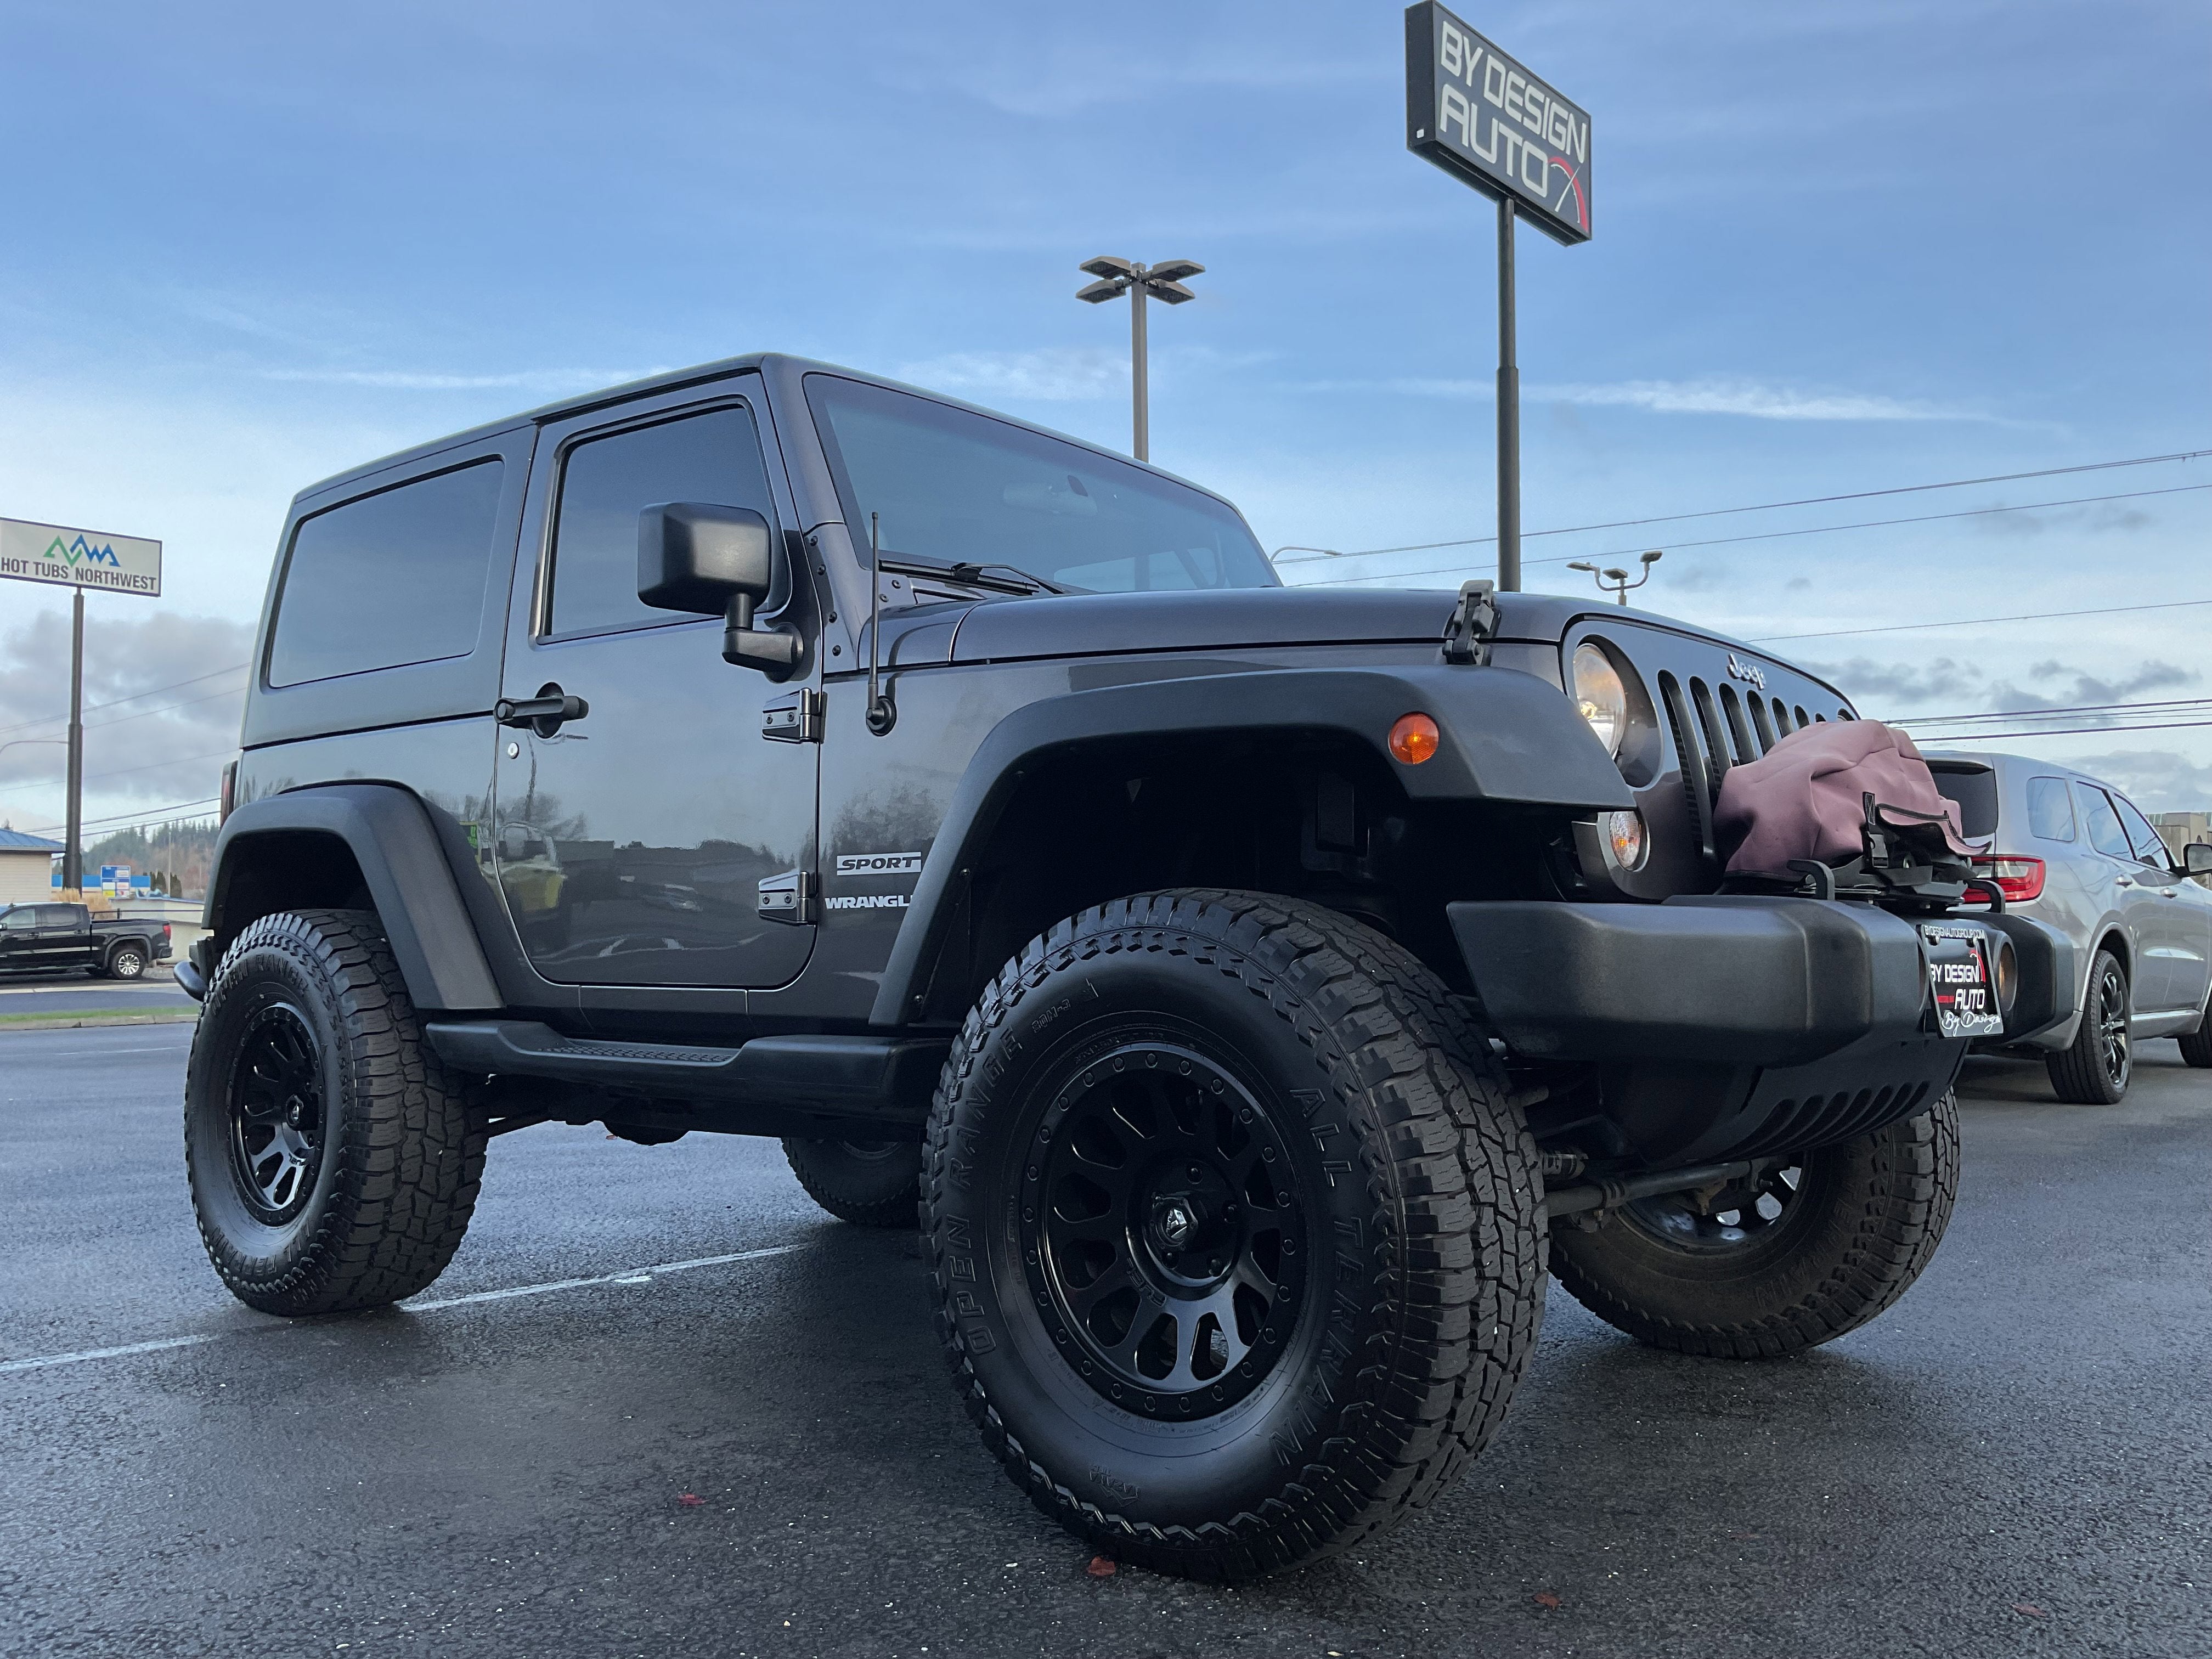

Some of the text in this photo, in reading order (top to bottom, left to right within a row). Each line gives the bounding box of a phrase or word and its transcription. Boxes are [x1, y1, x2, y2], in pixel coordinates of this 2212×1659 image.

[1441, 20, 1587, 163] BY DESIGN
[1440, 84, 1548, 198] AUTO
[1, 557, 156, 590] HOT TUBS NORTHWEST
[1728, 653, 1767, 690] Jeep
[839, 856, 919, 871] SPORT
[825, 895, 913, 909] WRANGL
[1944, 964, 1979, 983] DESIGN
[1954, 989, 1985, 1009] AUTO
[1941, 1011, 1960, 1037] By
[946, 1026, 1023, 1356] OPEN RANGE
[1269, 1088, 1364, 1466] ALL TERRAIN
